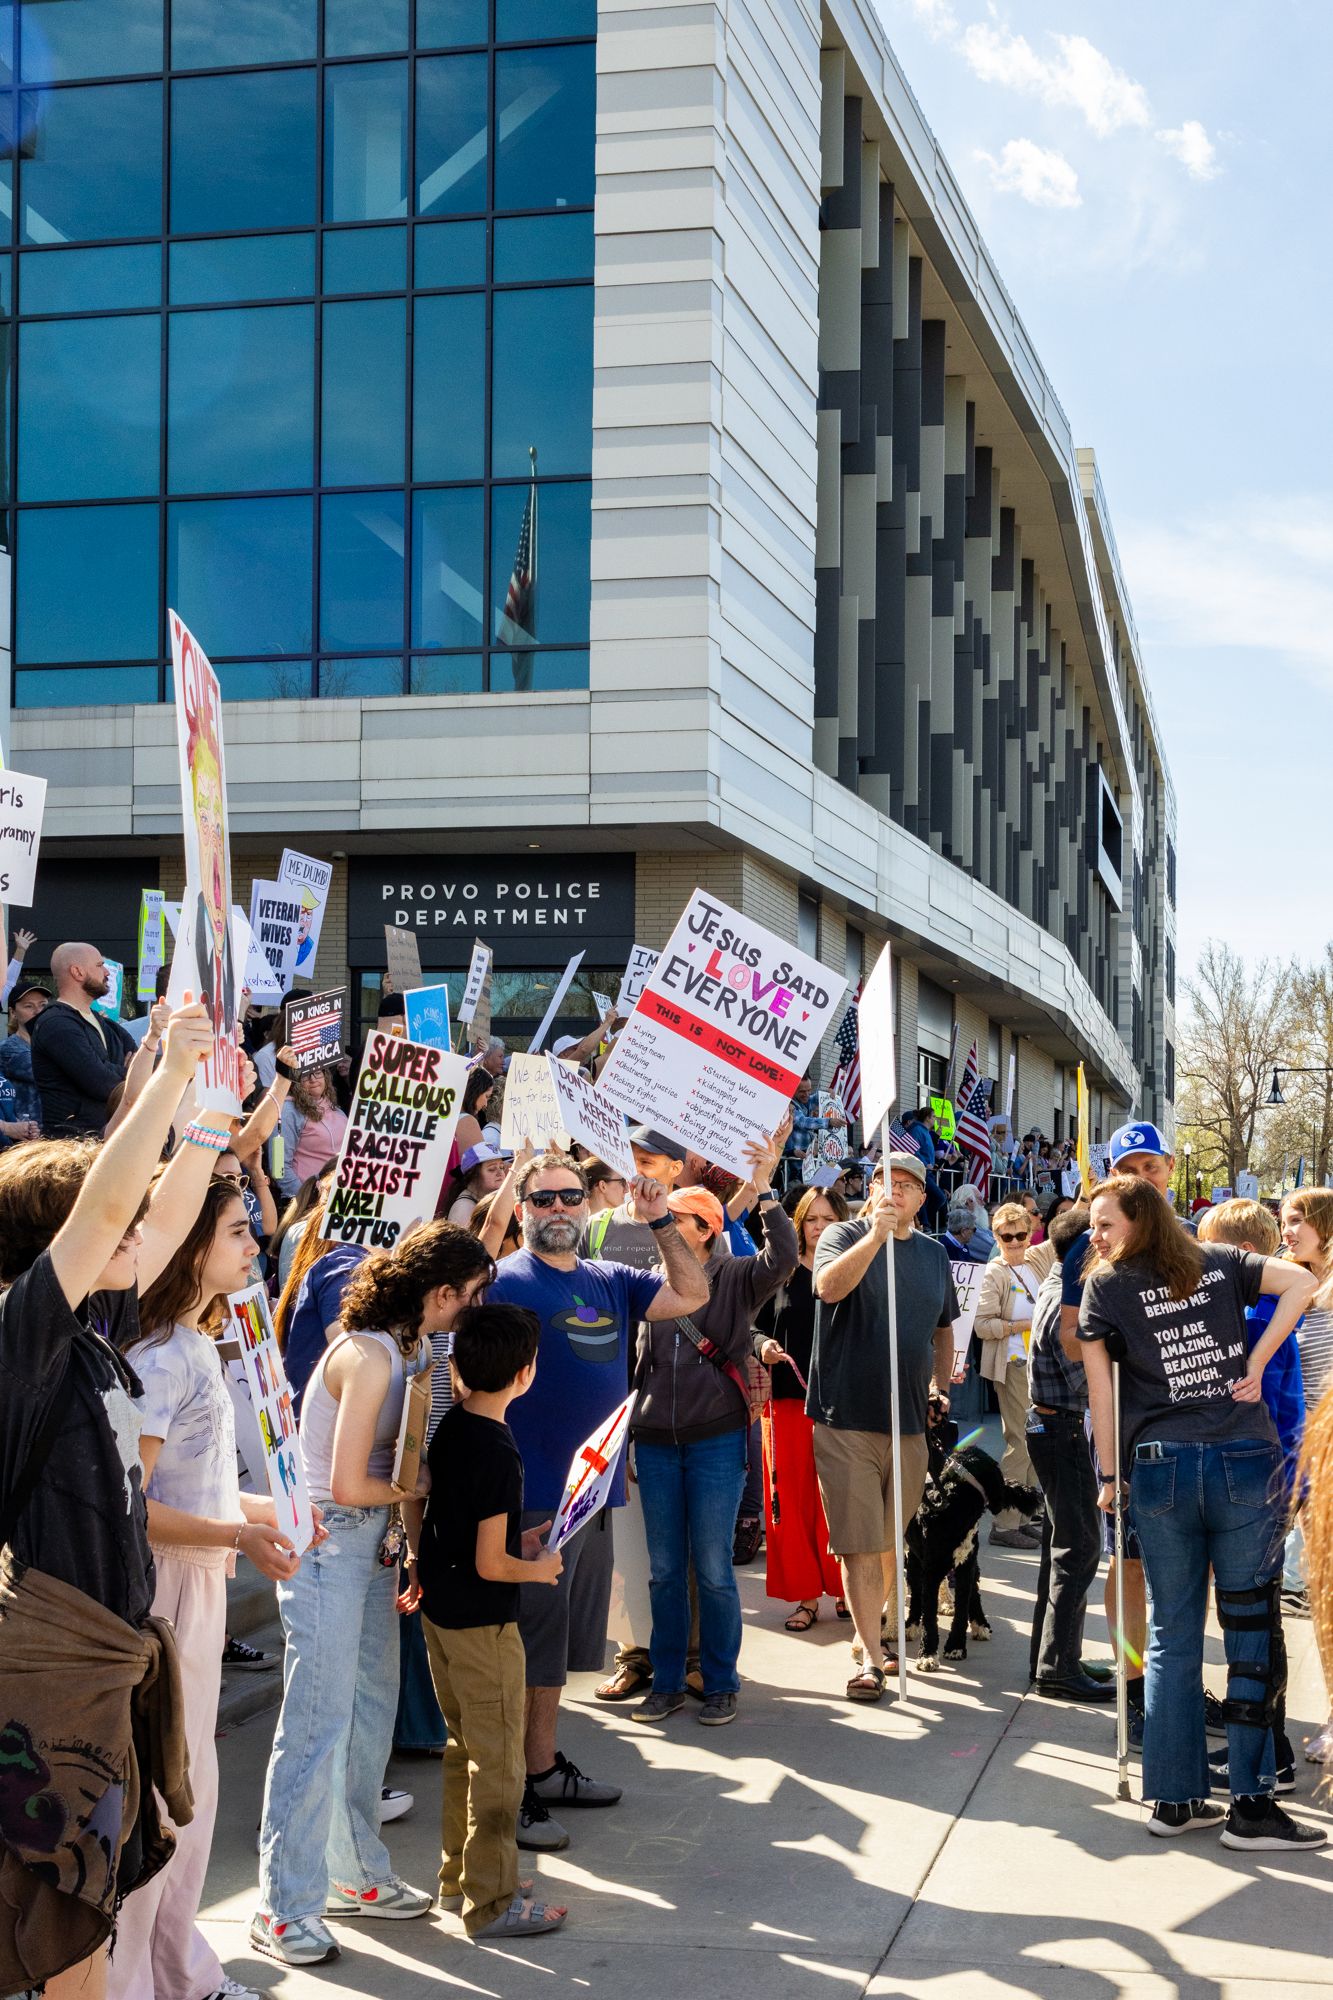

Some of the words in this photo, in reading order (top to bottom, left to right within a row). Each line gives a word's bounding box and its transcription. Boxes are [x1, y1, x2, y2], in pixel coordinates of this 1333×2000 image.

[382, 884, 479, 900] PROVO
[496, 883, 600, 899] POLICE
[259, 899, 300, 923] VETERAN
[395, 908, 587, 925] DEPARTMENT
[260, 922, 292, 946] WIVES
[265, 946, 283, 968] FOR
[704, 949, 795, 1019] LOVE
[772, 962, 829, 1009] SAID
[291, 1010, 304, 1023] NO
[307, 1002, 331, 1019] KINGS
[333, 998, 342, 1010] IN
[661, 955, 807, 1061] EVERYONE
[631, 1038, 648, 1055] Being
[649, 1047, 666, 1061] mean
[638, 1025, 657, 1044] Lying
[656, 1003, 682, 1025] THIS
[689, 1023, 703, 1036] IS
[716, 1038, 746, 1060] NOT
[749, 1057, 784, 1082] LOVE:
[368, 1033, 441, 1083] SUPER
[624, 1049, 650, 1070] Bullying
[358, 1068, 456, 1119] CALLOUS
[613, 1073, 635, 1094] Picking
[636, 1086, 657, 1103] fights
[619, 1061, 652, 1086] Obstructing
[651, 1080, 679, 1099] justice
[706, 1066, 736, 1091] Starting
[738, 1082, 758, 1098] Wars
[352, 1099, 439, 1141] FRAGILE
[557, 1079, 576, 1103] ME
[582, 1097, 621, 1137] REPEAT
[593, 1088, 624, 1123] MAKE
[606, 1086, 646, 1113] incarcerating
[645, 1106, 675, 1127] immigrants
[689, 1101, 728, 1131] objectifying
[696, 1090, 724, 1114] targeting
[724, 1106, 735, 1117] the
[736, 1113, 774, 1137] marginalized
[511, 1112, 529, 1137] NO
[683, 1112, 707, 1136] Being
[706, 1129, 734, 1149] greedy
[346, 1129, 427, 1170] RACIST
[679, 1125, 709, 1150] inciting
[709, 1142, 738, 1164] violence
[337, 1157, 420, 1198] SEXIST
[328, 1189, 385, 1218] NAZI
[323, 1213, 400, 1249] POTUS
[648, 1256, 656, 1265] C
[1139, 1290, 1156, 1304] TO
[1157, 1286, 1174, 1300] TH
[1194, 1269, 1226, 1290] RSON
[234, 1291, 271, 1352] TRUMP
[1144, 1298, 1189, 1318] BEHIND
[1189, 1291, 1211, 1307] ME:
[1154, 1327, 1180, 1344] YOU
[1182, 1321, 1207, 1338] ARE
[1163, 1348, 1227, 1375] BEAUTIFUL
[1228, 1341, 1244, 1358] AN
[1168, 1366, 1222, 1389] ENOUGH.
[1169, 1382, 1227, 1403] Remember
[568, 1485, 593, 1519] NO
